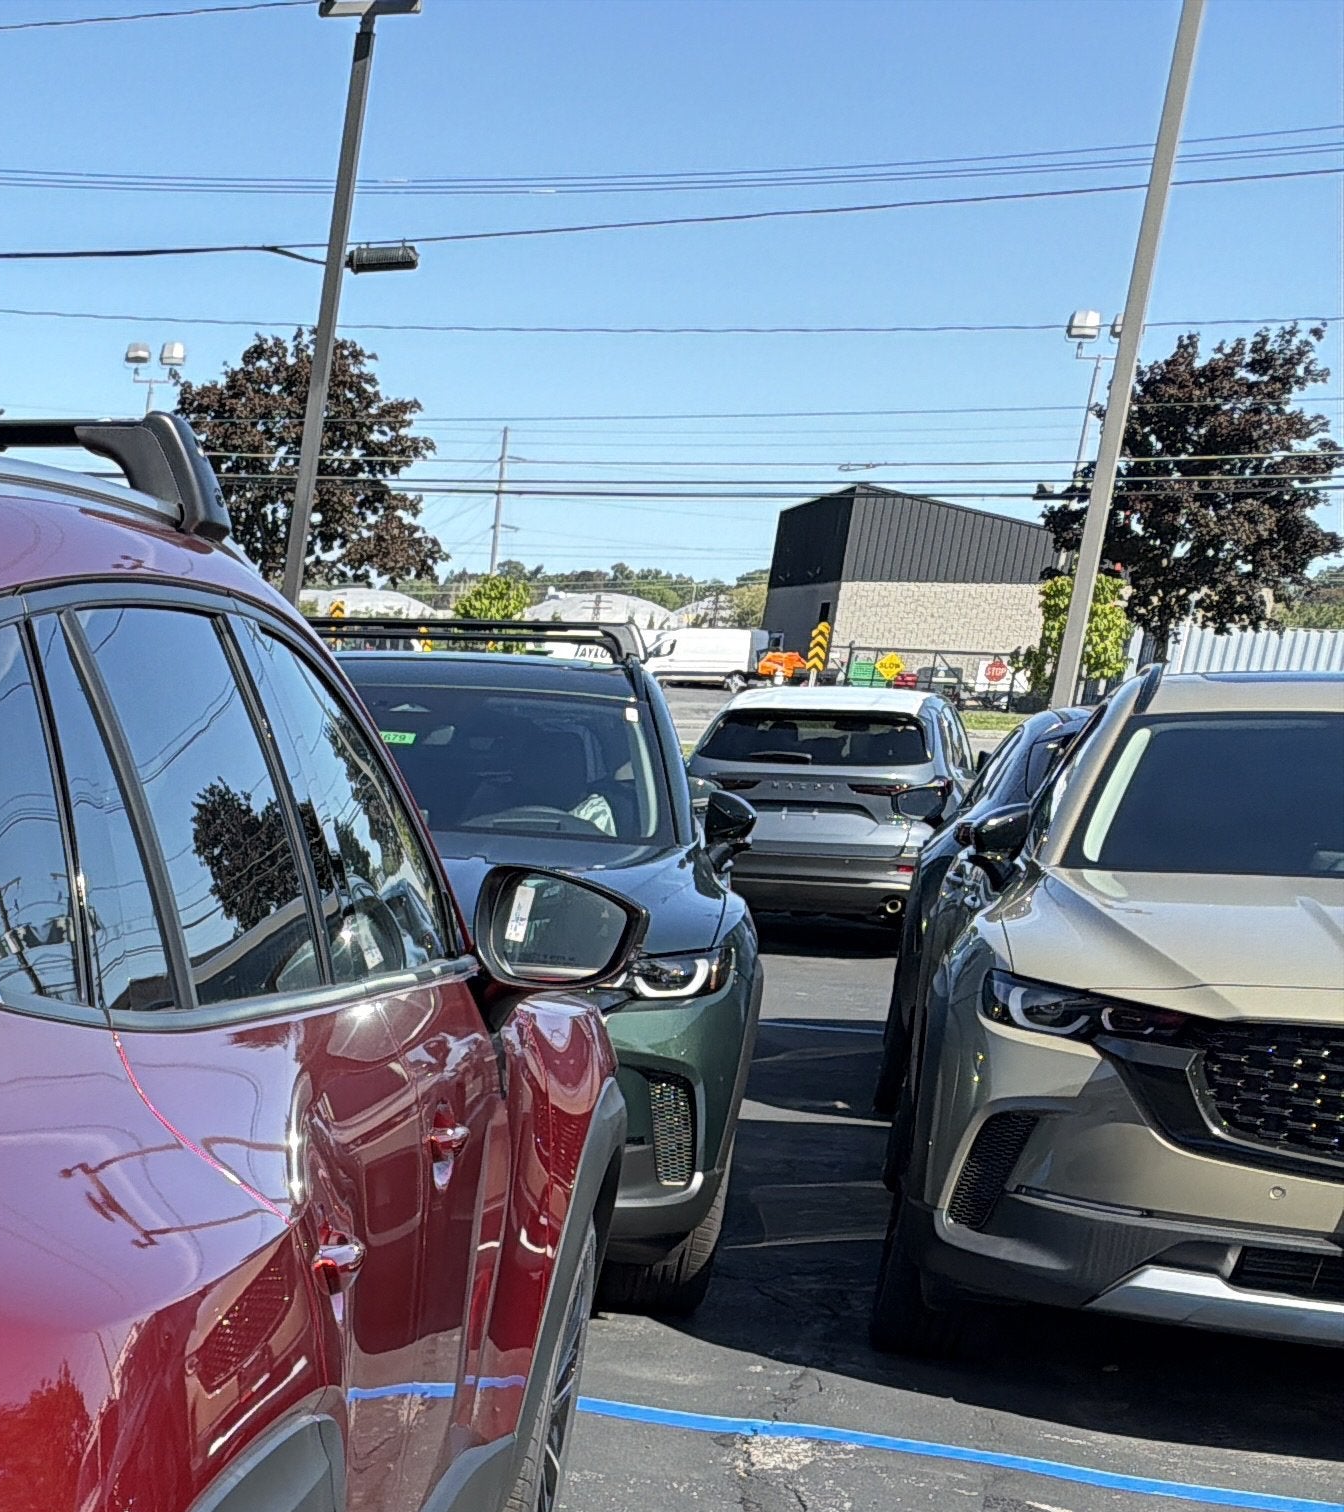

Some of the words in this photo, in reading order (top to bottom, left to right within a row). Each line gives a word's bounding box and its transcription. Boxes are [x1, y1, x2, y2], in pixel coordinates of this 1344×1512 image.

[879, 661, 900, 670] SLOW
[986, 666, 1007, 676] STOP
[380, 731, 406, 742] 679
